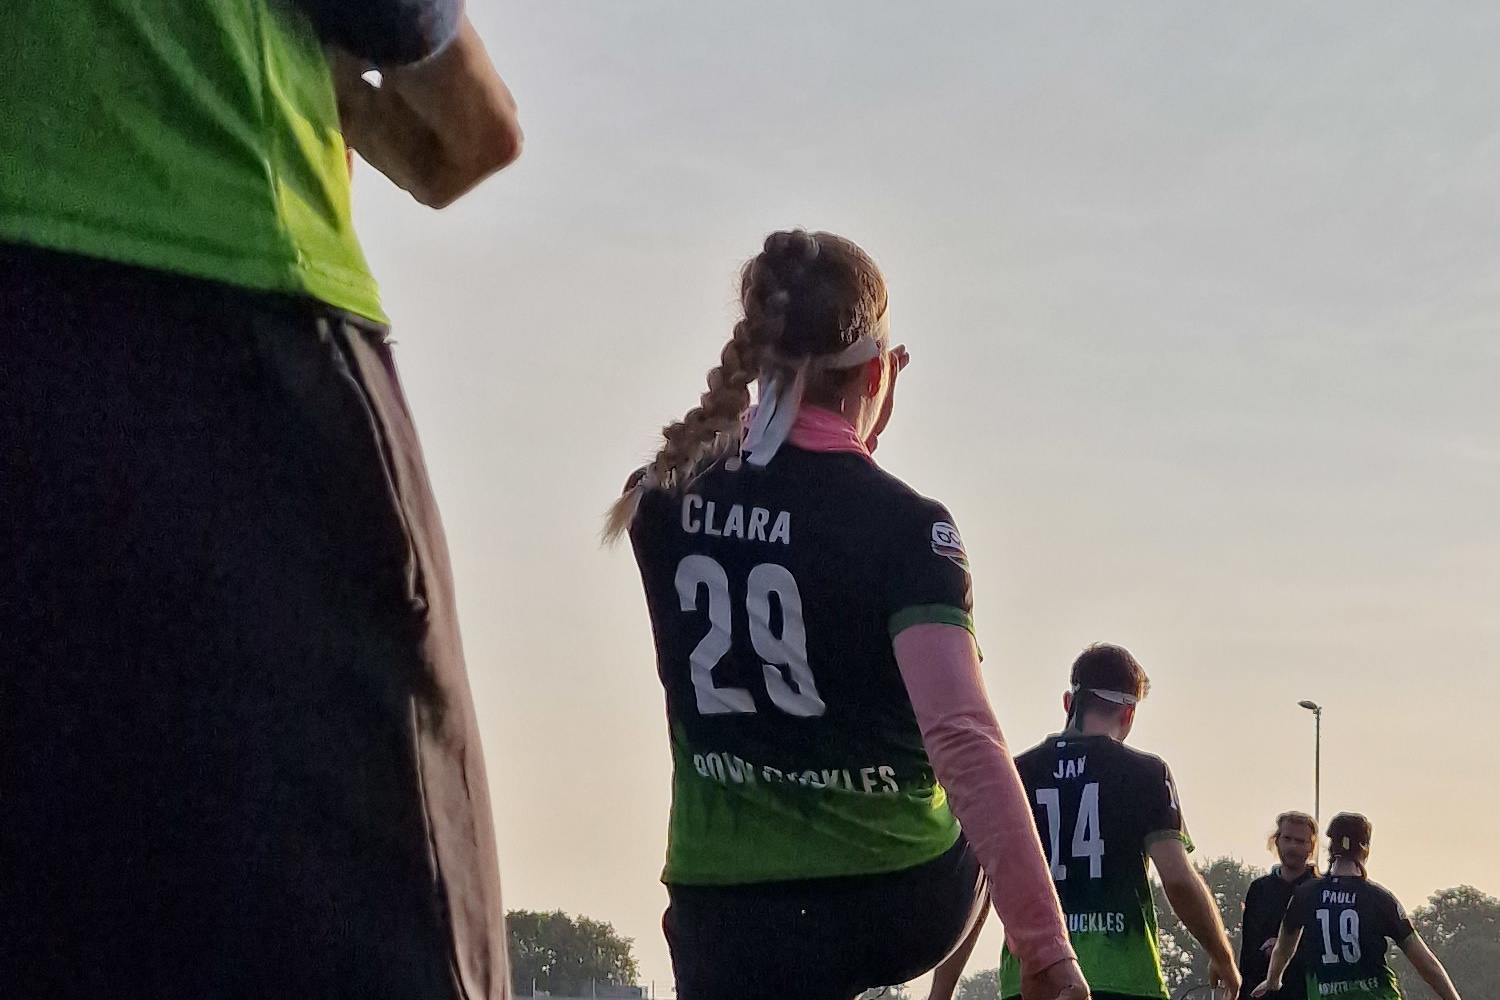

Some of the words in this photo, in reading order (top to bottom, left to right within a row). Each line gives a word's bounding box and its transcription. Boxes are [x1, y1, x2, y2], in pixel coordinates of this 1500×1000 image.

[682, 494, 791, 544] CLARA
[674, 554, 827, 717] 29
[1035, 782, 1105, 881] 14
[1322, 889, 1357, 904] PAULI
[1316, 908, 1361, 964] 19
